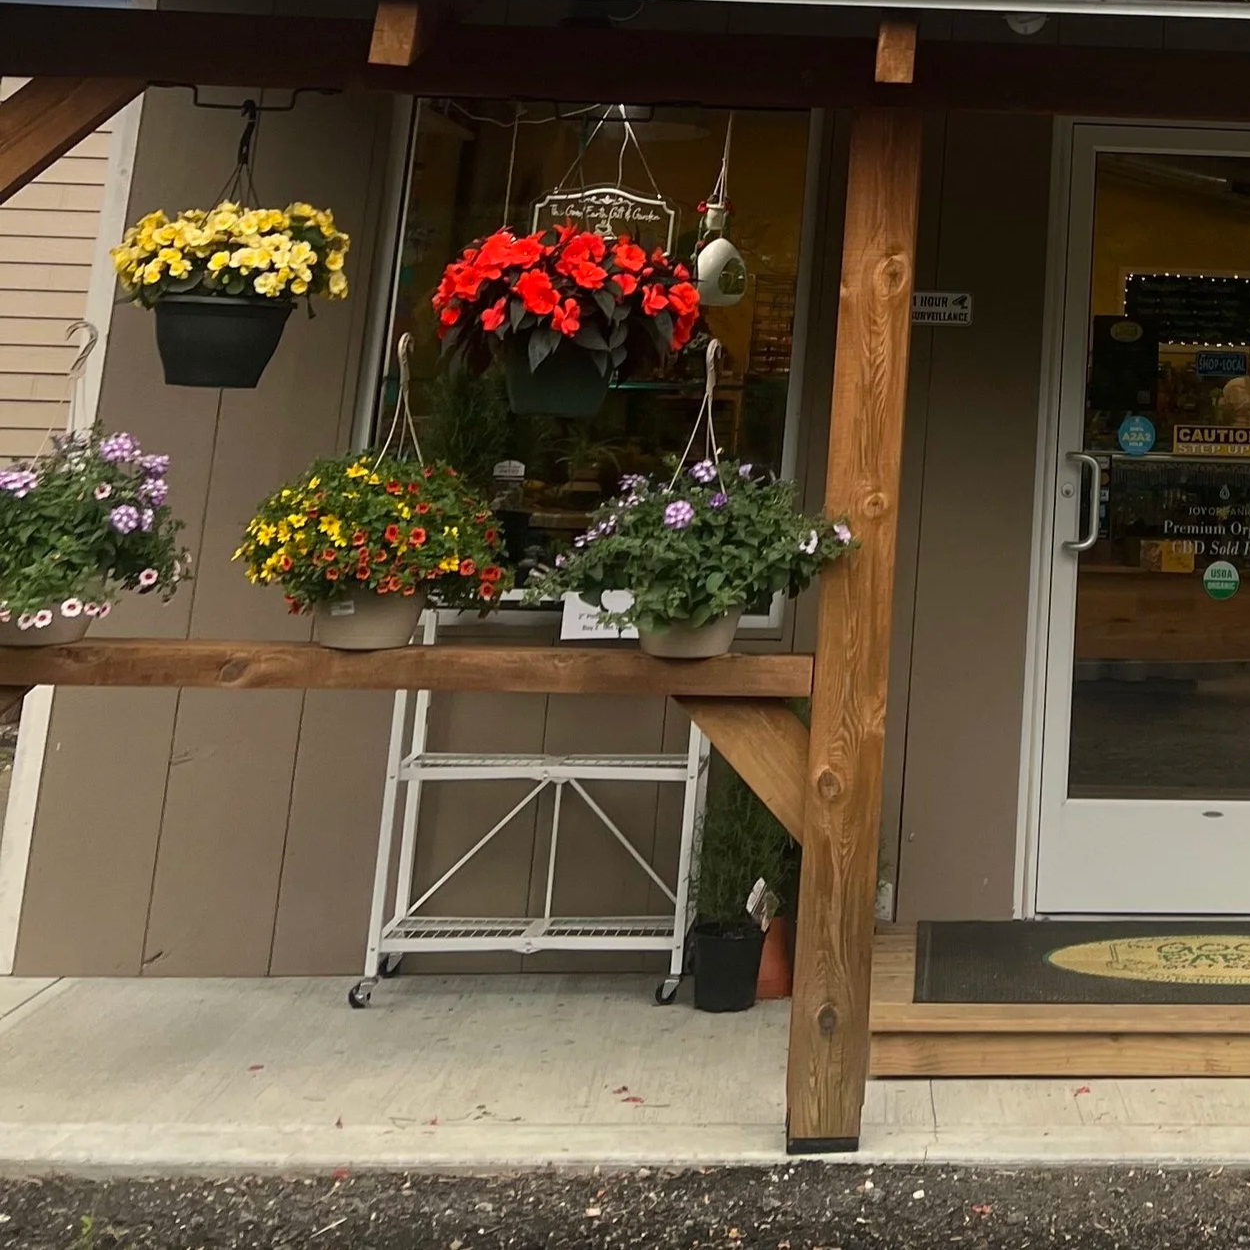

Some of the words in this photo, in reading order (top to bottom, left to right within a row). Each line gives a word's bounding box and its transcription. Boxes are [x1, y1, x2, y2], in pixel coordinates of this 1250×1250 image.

[920, 295, 949, 308] HOUR
[1198, 357, 1219, 371] SHOP
[1222, 358, 1246, 373] LOCAL
[1122, 431, 1152, 442] A2A2
[1178, 444, 1221, 454] STEP
[1227, 445, 1249, 454] UP
[1163, 519, 1226, 535] Premium
[1171, 539, 1206, 556] CBD
[1209, 540, 1241, 556] Sold
[1210, 569, 1233, 579] USDA
